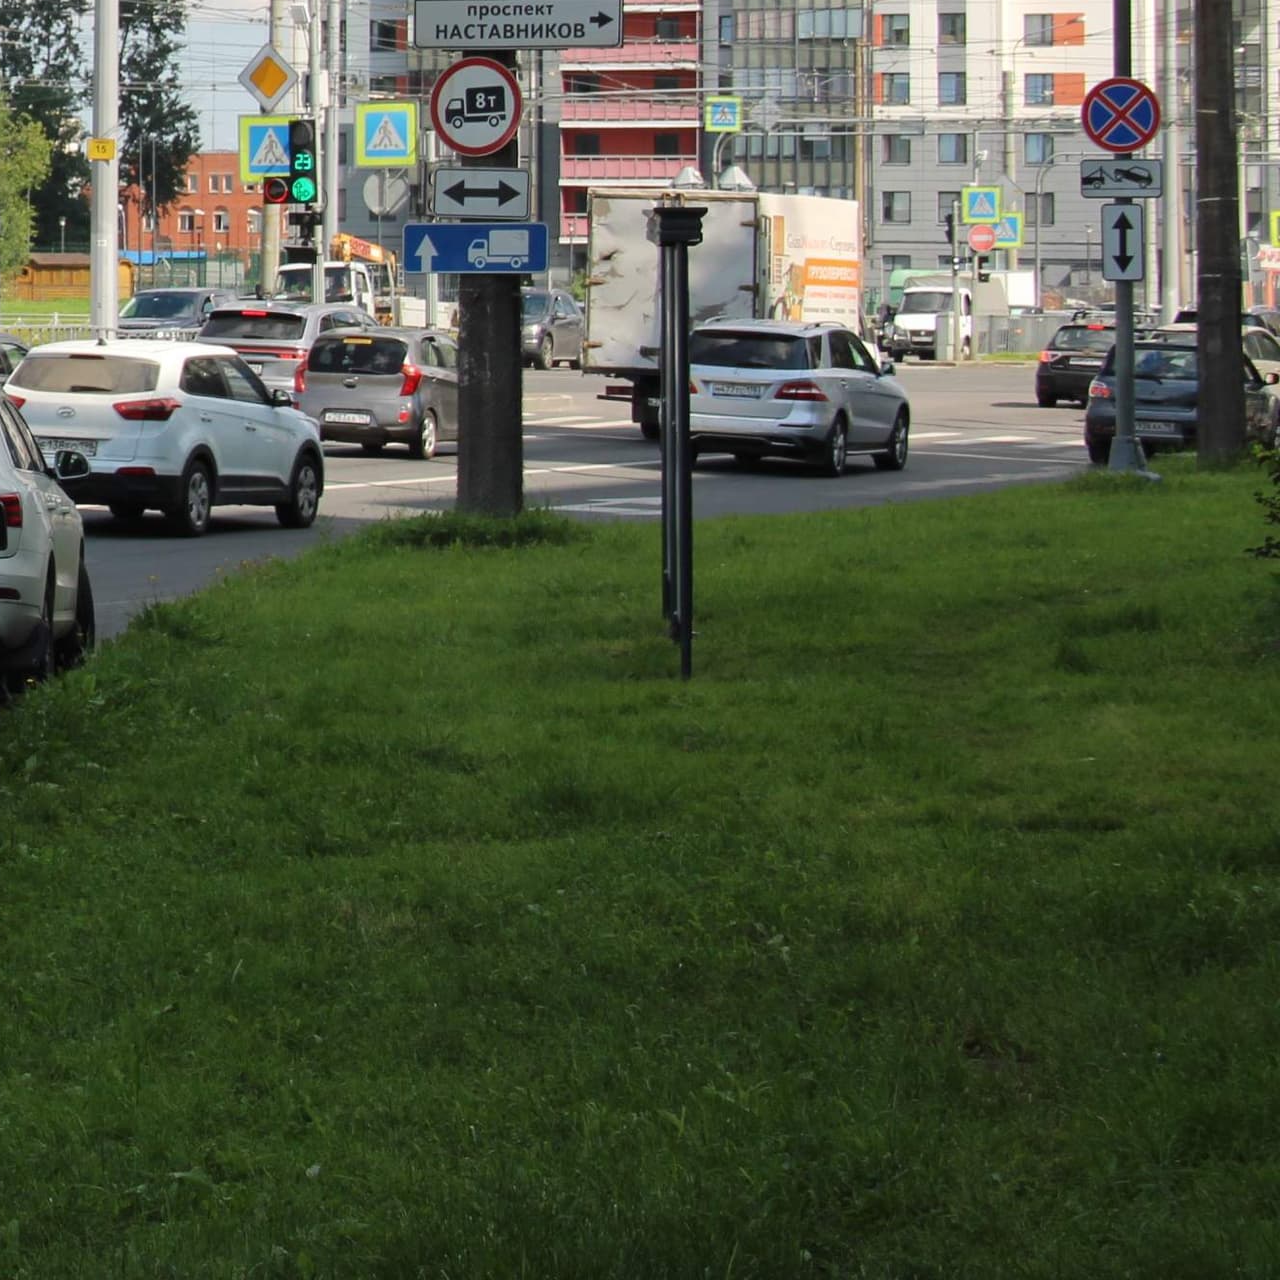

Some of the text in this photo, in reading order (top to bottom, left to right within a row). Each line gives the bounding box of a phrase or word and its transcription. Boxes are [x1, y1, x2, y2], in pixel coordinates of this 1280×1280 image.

[467, 2, 554, 19] проспект
[435, 23, 586, 40] НАСТАВНИКОВ
[294, 153, 312, 170] 23
